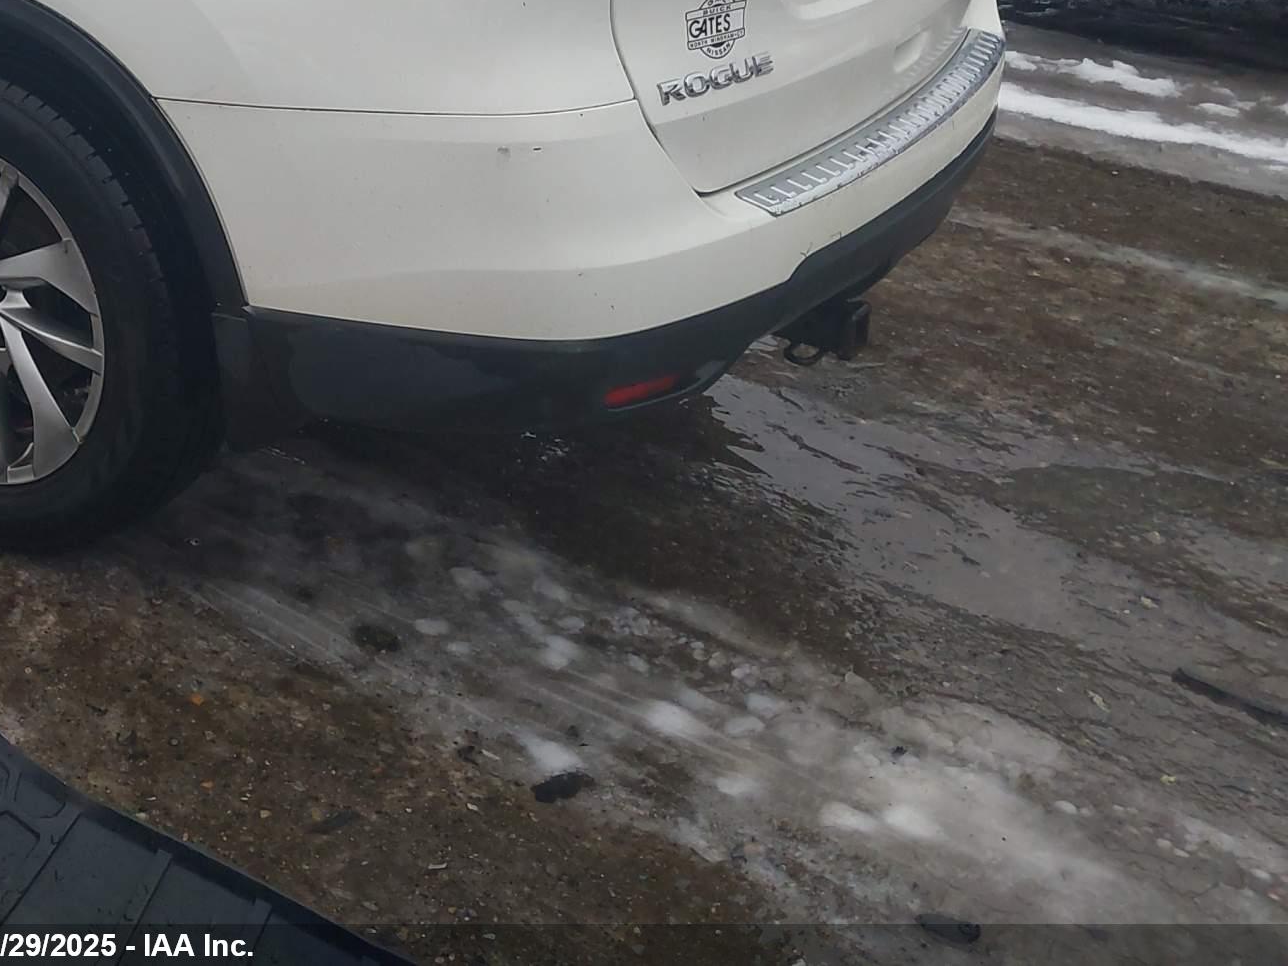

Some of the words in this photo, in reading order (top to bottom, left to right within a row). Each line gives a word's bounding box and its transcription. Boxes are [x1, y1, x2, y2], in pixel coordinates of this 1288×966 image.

[703, 5, 732, 16] BUICK
[689, 13, 731, 38] GATES
[706, 42, 731, 56] NISSAN
[656, 53, 774, 106] ROGUE
